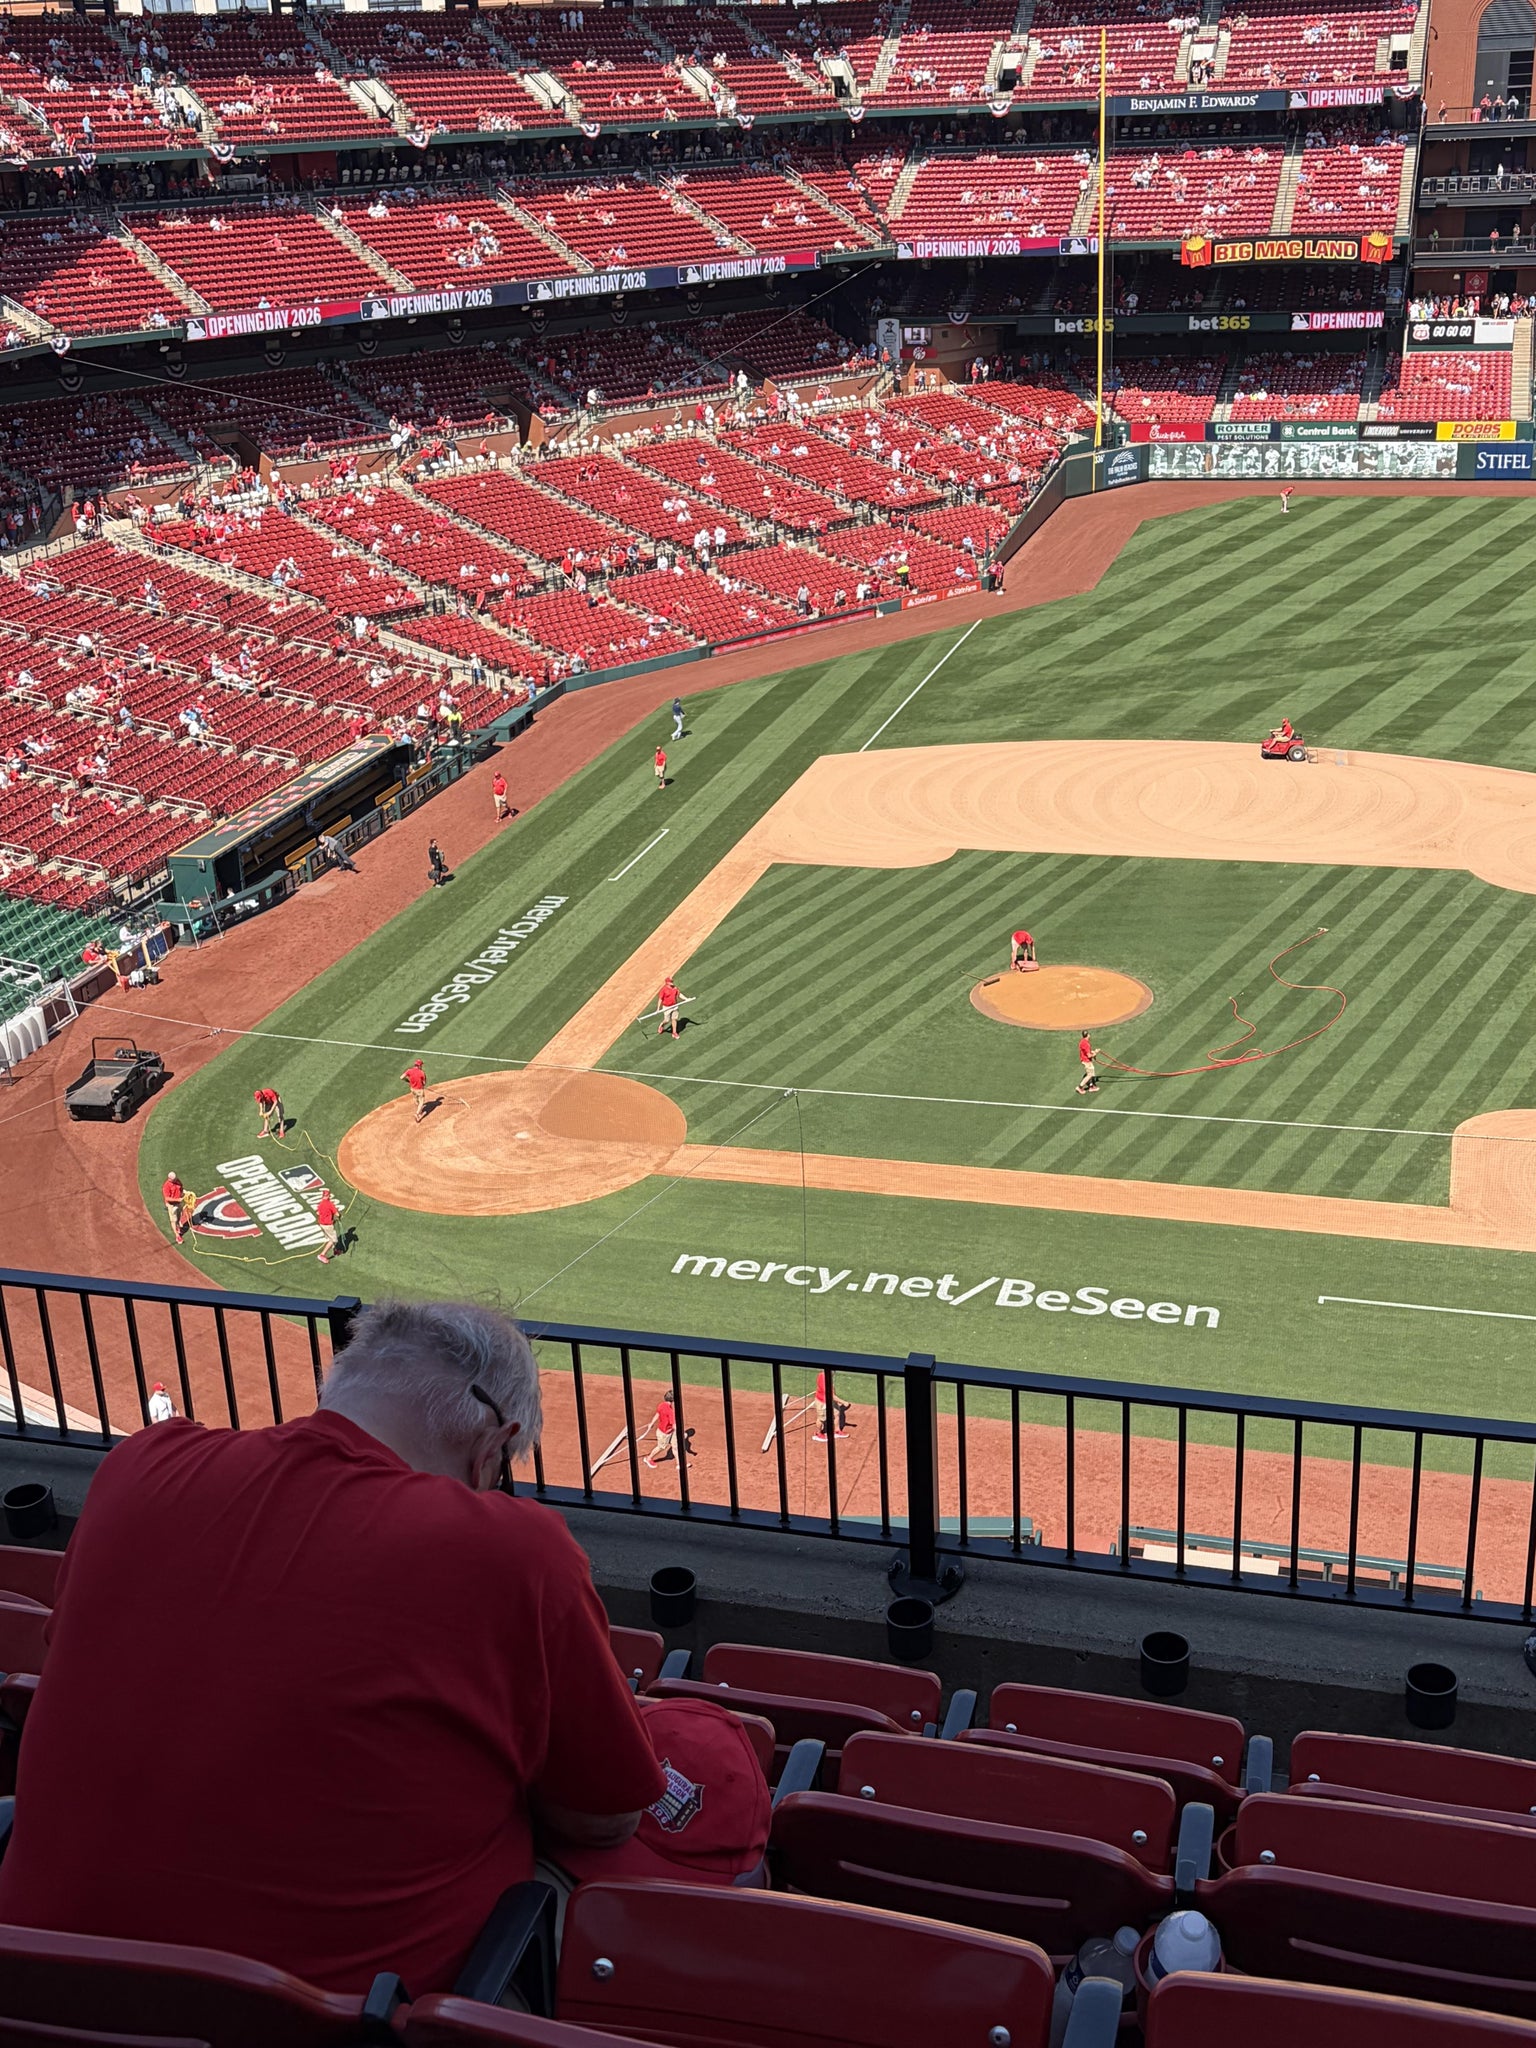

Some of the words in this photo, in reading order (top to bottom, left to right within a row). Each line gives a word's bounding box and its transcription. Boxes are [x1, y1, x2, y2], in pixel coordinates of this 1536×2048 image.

[1130, 98, 1186, 111] BENJAMIN
[1189, 97, 1198, 109] F.
[1201, 95, 1259, 108] EDWARDS
[917, 242, 967, 257] OPENING
[968, 240, 990, 256] DAY
[992, 239, 1021, 255] 2026
[1214, 242, 1252, 263] BIG
[1254, 240, 1304, 261] MAC
[1305, 240, 1358, 260] LAND
[763, 256, 786, 273] 2026
[621, 271, 647, 290] 2026
[466, 288, 493, 307] 2026
[291, 307, 321, 328] 2026
[1188, 315, 1250, 330] bet365
[1433, 326, 1445, 337] GO
[1446, 326, 1459, 337] GO
[1217, 425, 1269, 433] ROTTLER
[1297, 426, 1331, 436] Central
[1332, 425, 1357, 436] Bank
[1362, 425, 1400, 437] LINDENWOOD
[1453, 423, 1501, 434] DOBBS
[1476, 451, 1531, 470] STIFEL
[393, 895, 570, 1033] mercy.net/BeSeen
[216, 1154, 304, 1222] OPENING
[265, 1211, 330, 1250] DAY
[671, 1250, 1221, 1329] mercy.net/BeSeen
